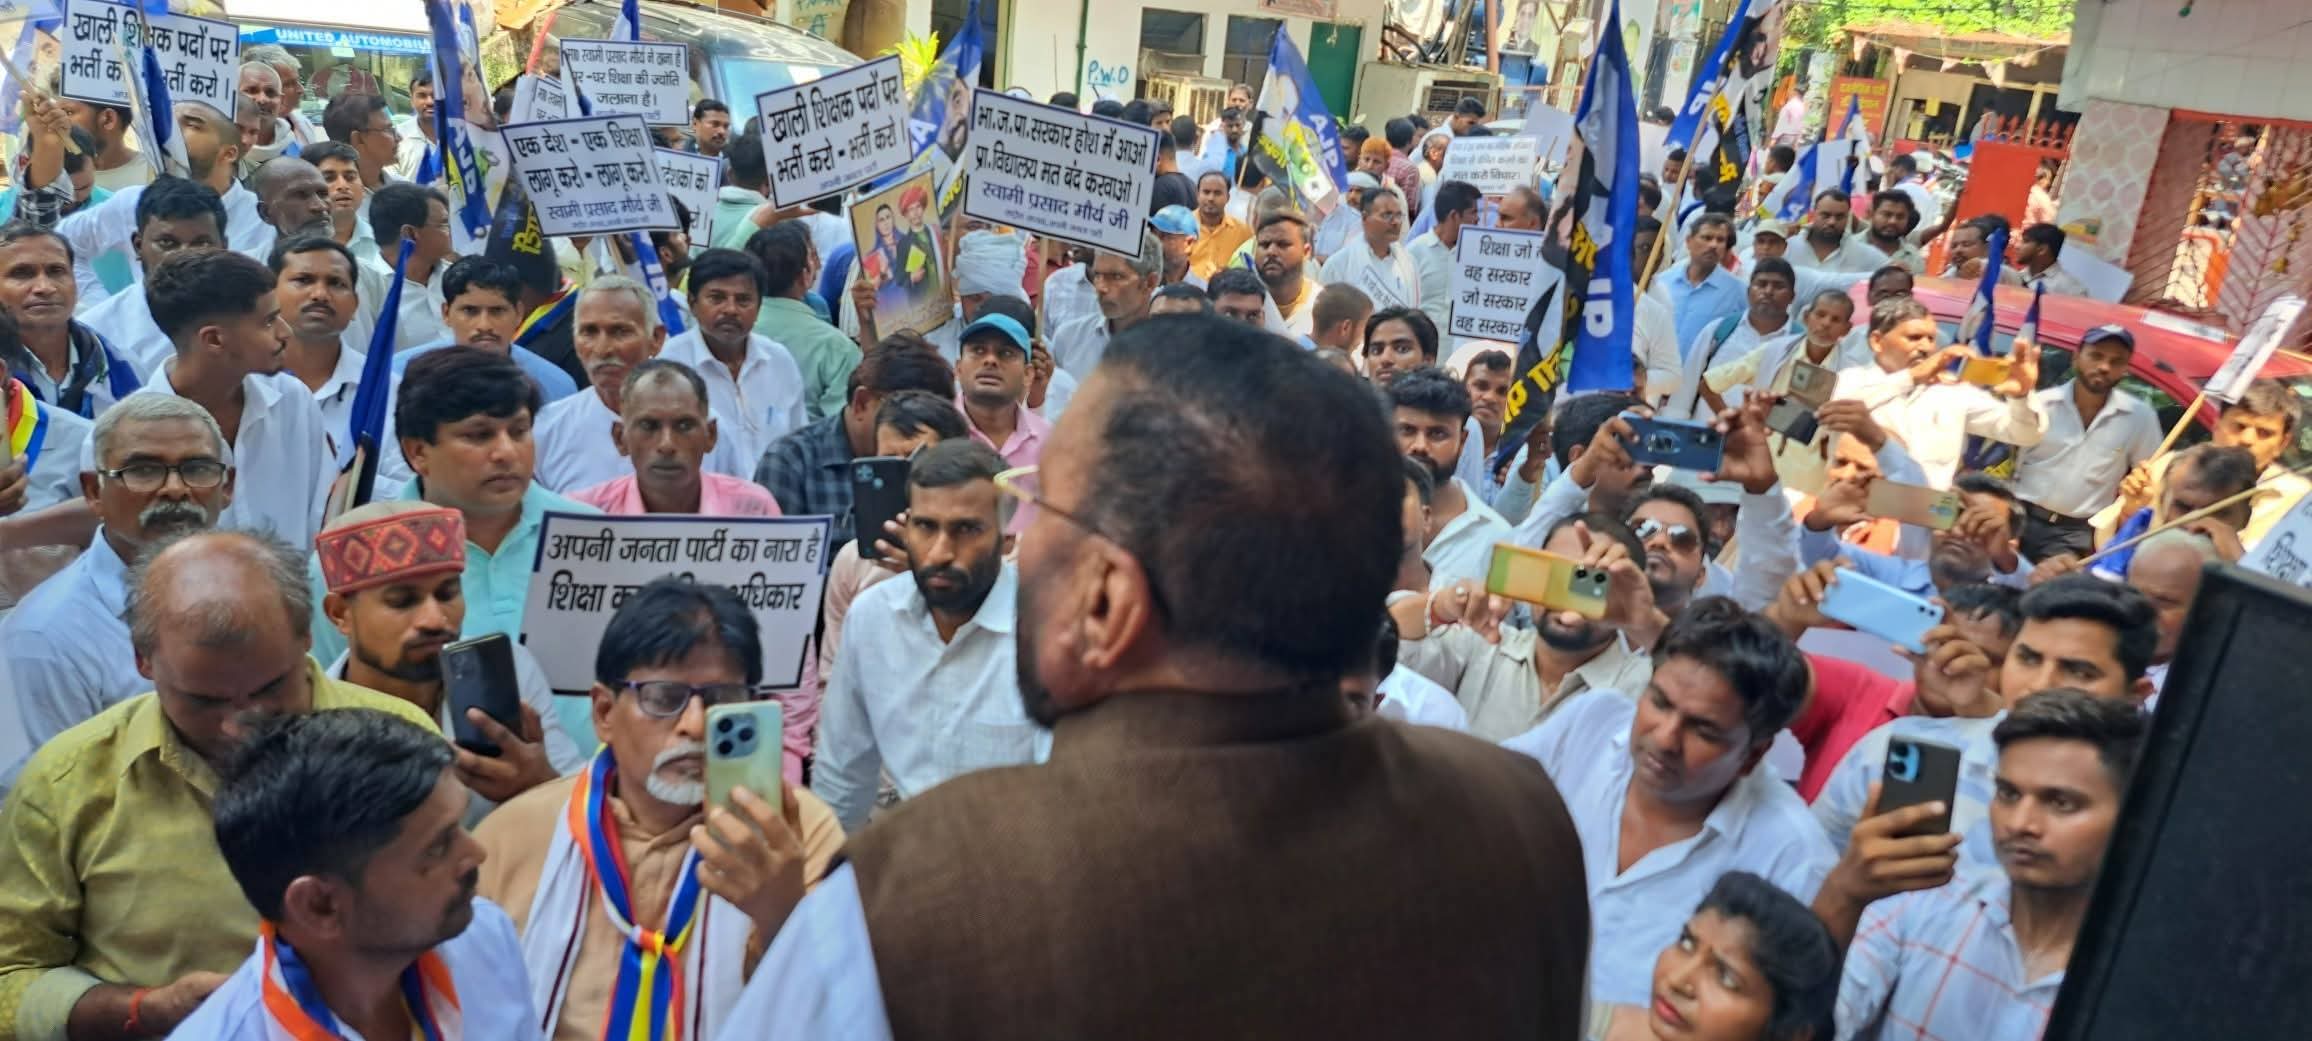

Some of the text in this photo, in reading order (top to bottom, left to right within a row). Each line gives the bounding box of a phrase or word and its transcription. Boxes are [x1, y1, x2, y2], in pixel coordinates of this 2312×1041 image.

[73, 7, 117, 45] खाली
[178, 26, 208, 60] पदों
[210, 36, 231, 64] पर
[275, 28, 335, 42] UNITED
[70, 49, 104, 80] भर्ती
[608, 68, 633, 85] शिक्षा
[635, 69, 649, 85] की
[189, 70, 218, 98] करो
[596, 92, 639, 106] जलाना
[768, 70, 899, 142] खाली शिक्षक पदों पर
[513, 136, 541, 158] एक
[542, 128, 566, 153] देश
[581, 130, 607, 150] एक
[607, 121, 645, 148] शिक्षा
[776, 143, 805, 183] भर्ती
[807, 137, 835, 173] करो
[849, 122, 872, 160] भर्ती
[873, 115, 896, 151] करो
[1073, 122, 1100, 155] होश
[1102, 127, 1117, 159] में
[1115, 135, 1148, 167] आओ
[525, 168, 560, 197] लागू
[555, 157, 585, 188] करो
[594, 160, 630, 192] लागू
[624, 153, 651, 184] करो
[1040, 161, 1063, 187] मत
[1085, 172, 1133, 205] करवाओ
[546, 192, 663, 220] स्वामी प्रसाद मौर्य जी
[982, 181, 1024, 205] स्वामी
[1028, 193, 1069, 216] प्रसाद
[1073, 199, 1105, 224] मौर्य
[1109, 208, 1129, 231] जी
[1479, 234, 1511, 257] शिक्षा
[1514, 240, 1532, 259] जो
[1464, 265, 1532, 286] वह सरकार
[1461, 286, 1528, 311] जो सरकार
[1456, 315, 1521, 337] वह सरकार
[548, 527, 820, 563] अपनी जनता पार्टी का नारा है
[547, 568, 607, 612] शिक्षा
